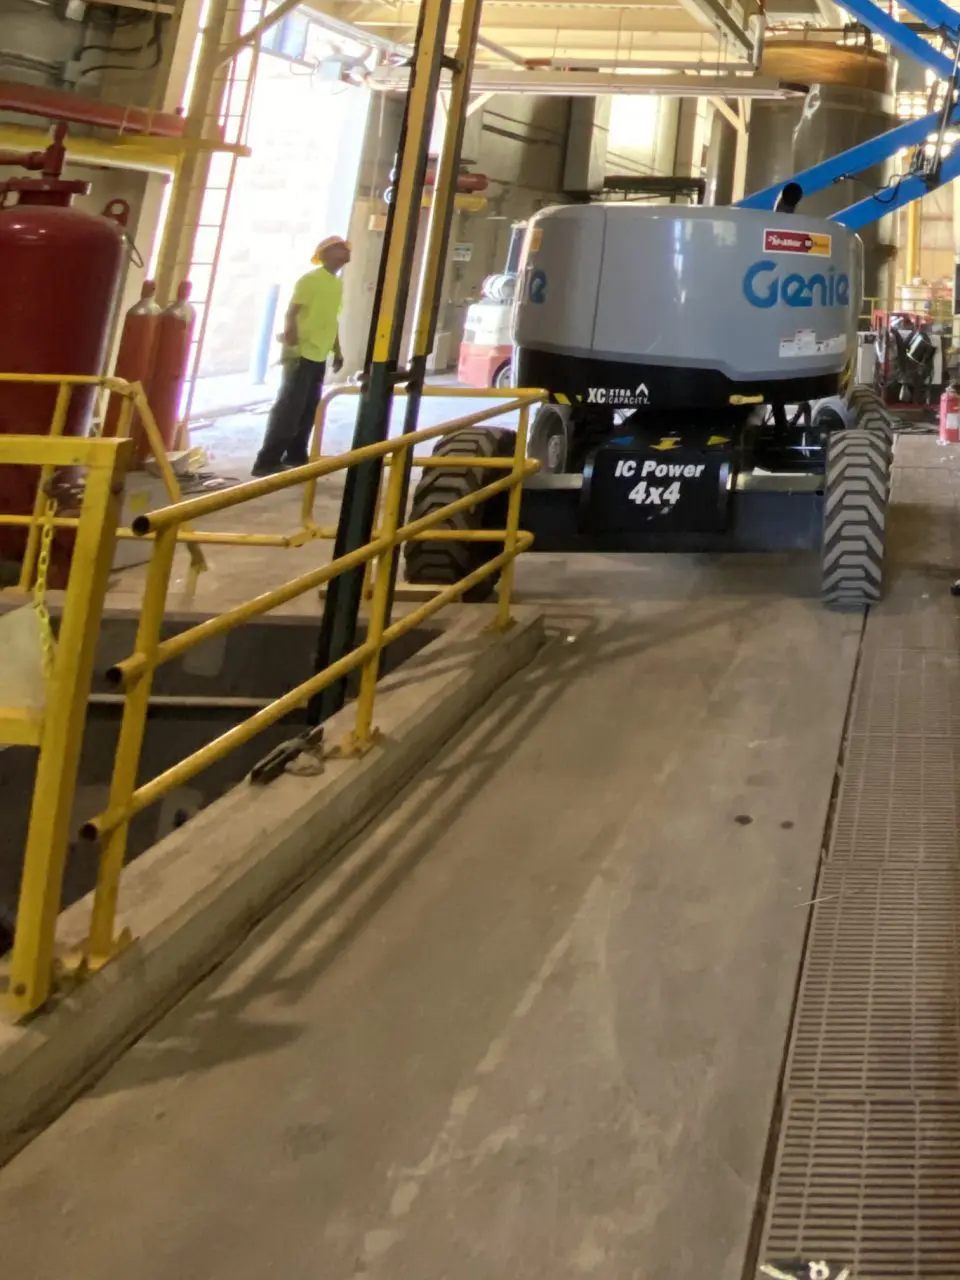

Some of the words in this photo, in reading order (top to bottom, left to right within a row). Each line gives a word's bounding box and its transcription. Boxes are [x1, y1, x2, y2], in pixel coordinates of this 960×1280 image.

[742, 260, 849, 308] Genie
[586, 387, 607, 404] XC
[608, 396, 649, 405] CAPACITY
[614, 460, 637, 477] IC
[640, 460, 706, 478] Power
[628, 481, 681, 505] 4x4
